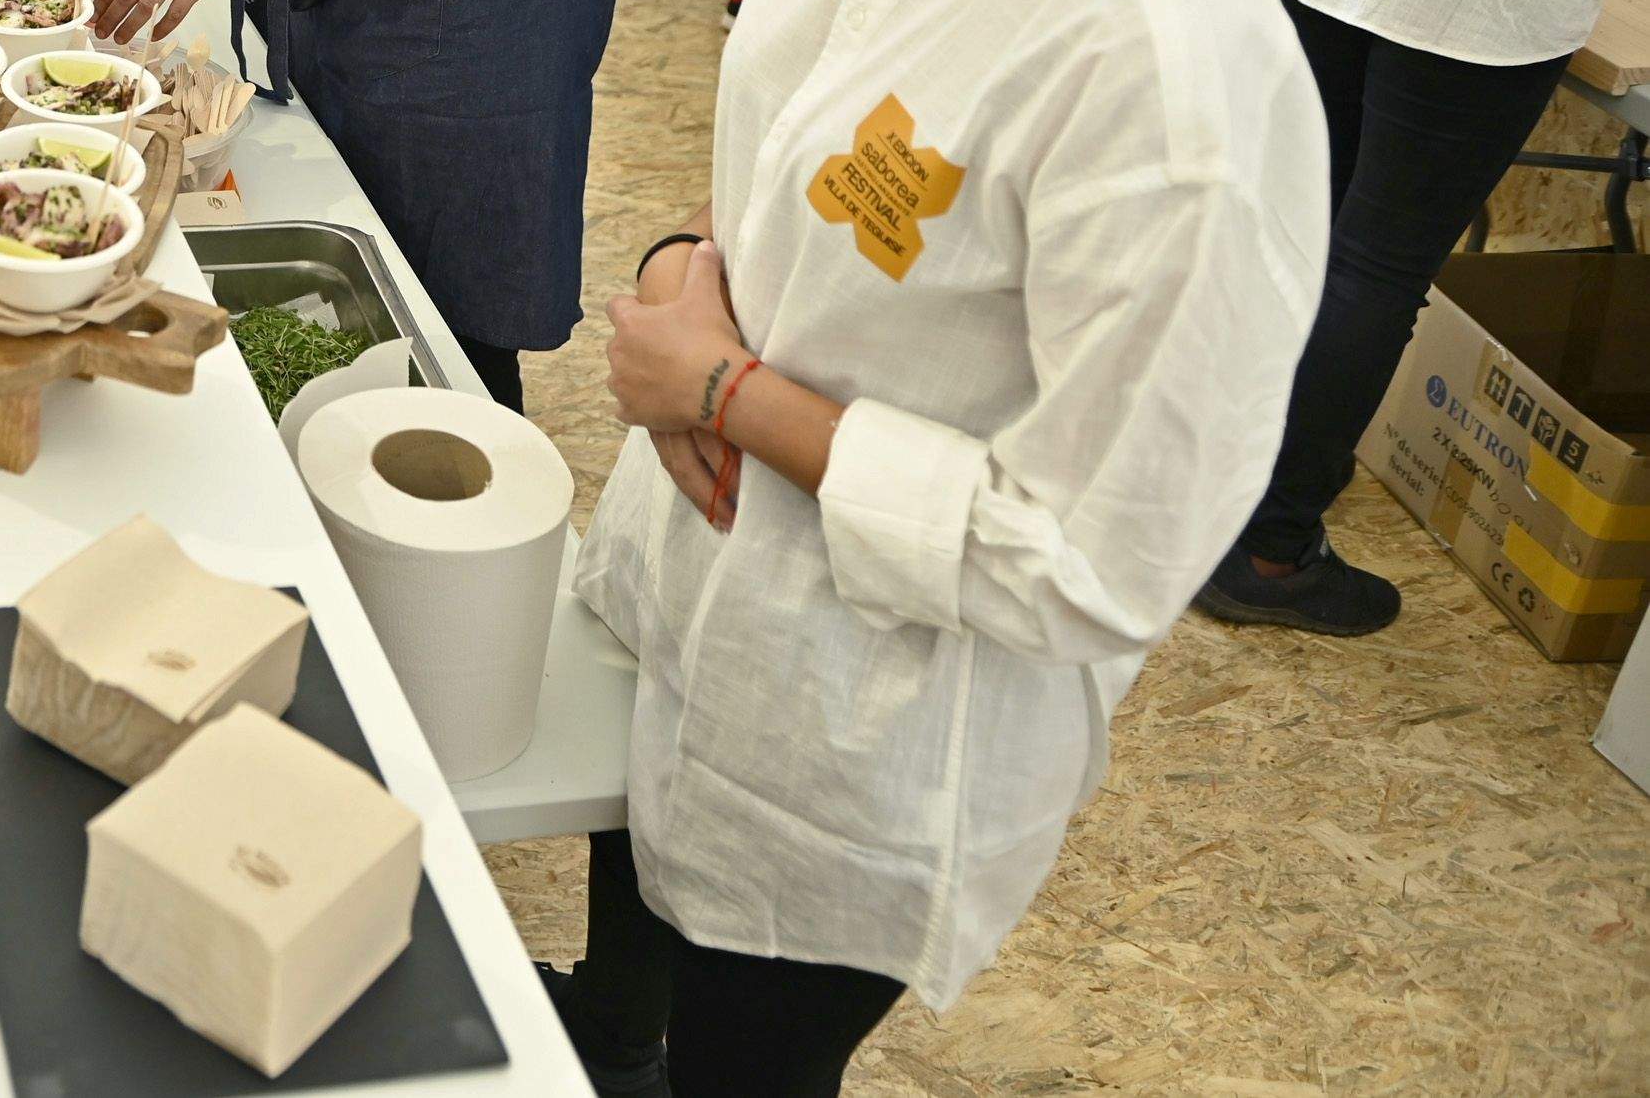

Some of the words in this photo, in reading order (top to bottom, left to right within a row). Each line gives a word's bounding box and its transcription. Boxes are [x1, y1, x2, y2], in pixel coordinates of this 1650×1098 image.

[841, 162, 901, 232] FESTIVAL
[861, 141, 920, 208] saborea
[823, 174, 848, 207] VILLA
[845, 202, 861, 218] DE
[861, 213, 908, 257] TEGUISE
[1397, 438, 1412, 458] de
[1447, 396, 1528, 482] EUTRON
[1568, 440, 1580, 457] 5
